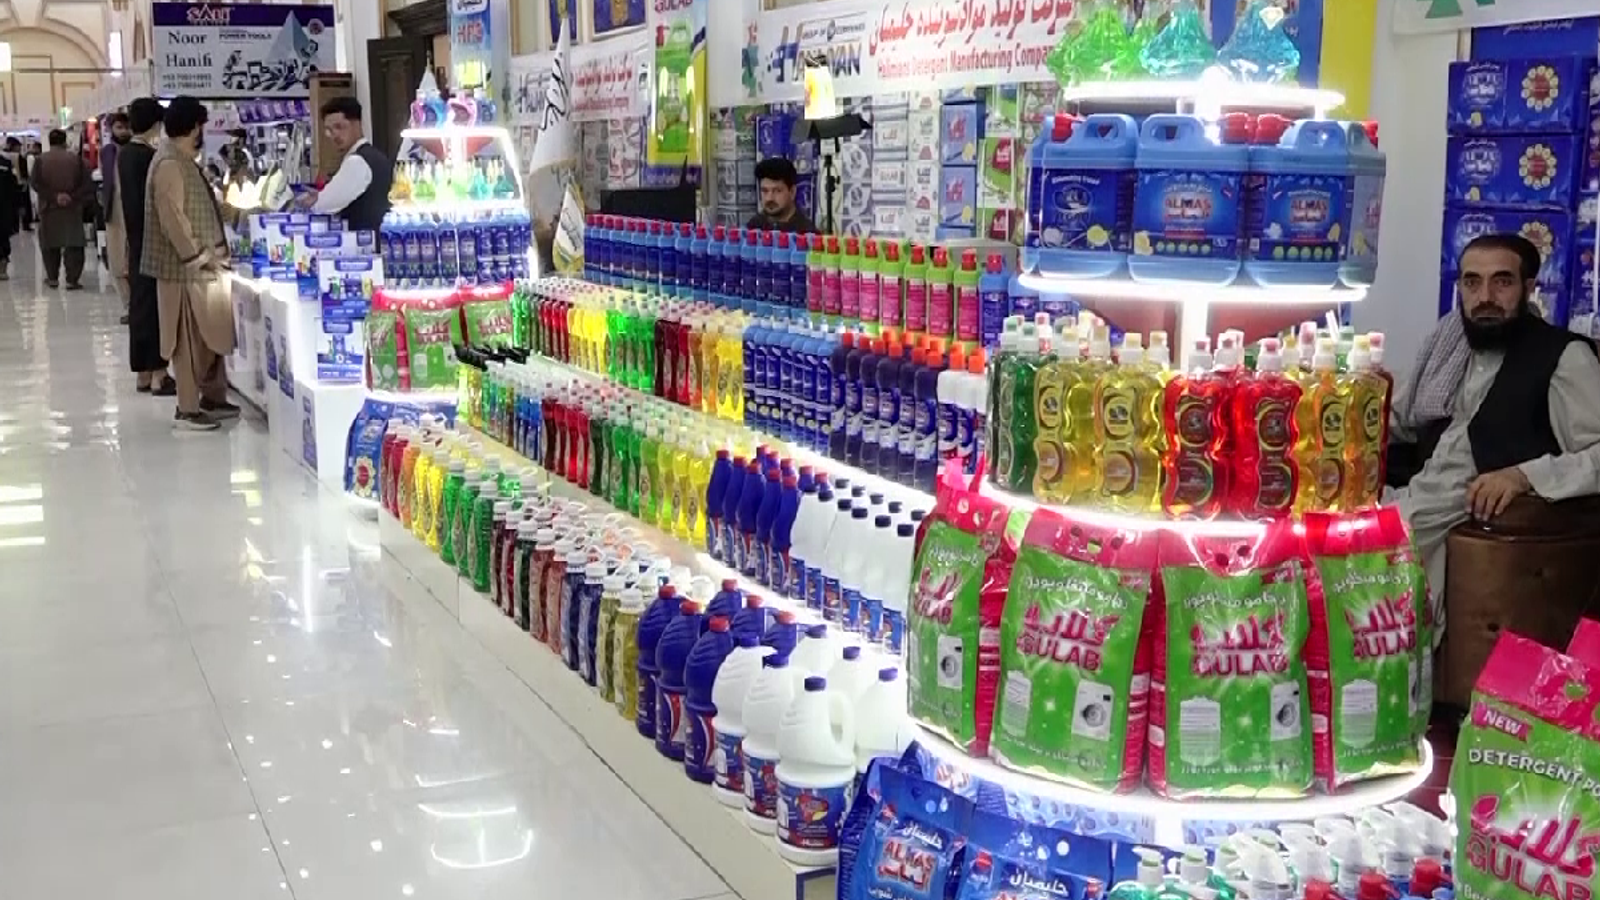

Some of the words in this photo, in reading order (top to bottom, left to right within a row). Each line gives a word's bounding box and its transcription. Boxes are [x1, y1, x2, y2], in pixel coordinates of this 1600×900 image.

[168, 31, 208, 45] Noor
[166, 53, 213, 68] Hanifi
[951, 46, 1012, 73] Manufacturing
[1014, 43, 1052, 71] Compa
[1165, 197, 1212, 209] ALMAS
[1291, 199, 1328, 210] ALMAS
[1015, 629, 1102, 672] GULAB
[1192, 652, 1288, 677] GULAB
[1484, 710, 1522, 735] NEW
[1468, 748, 1583, 785] DETERGENT
[884, 840, 936, 872] ALMAS
[1465, 830, 1594, 900] GULAB
